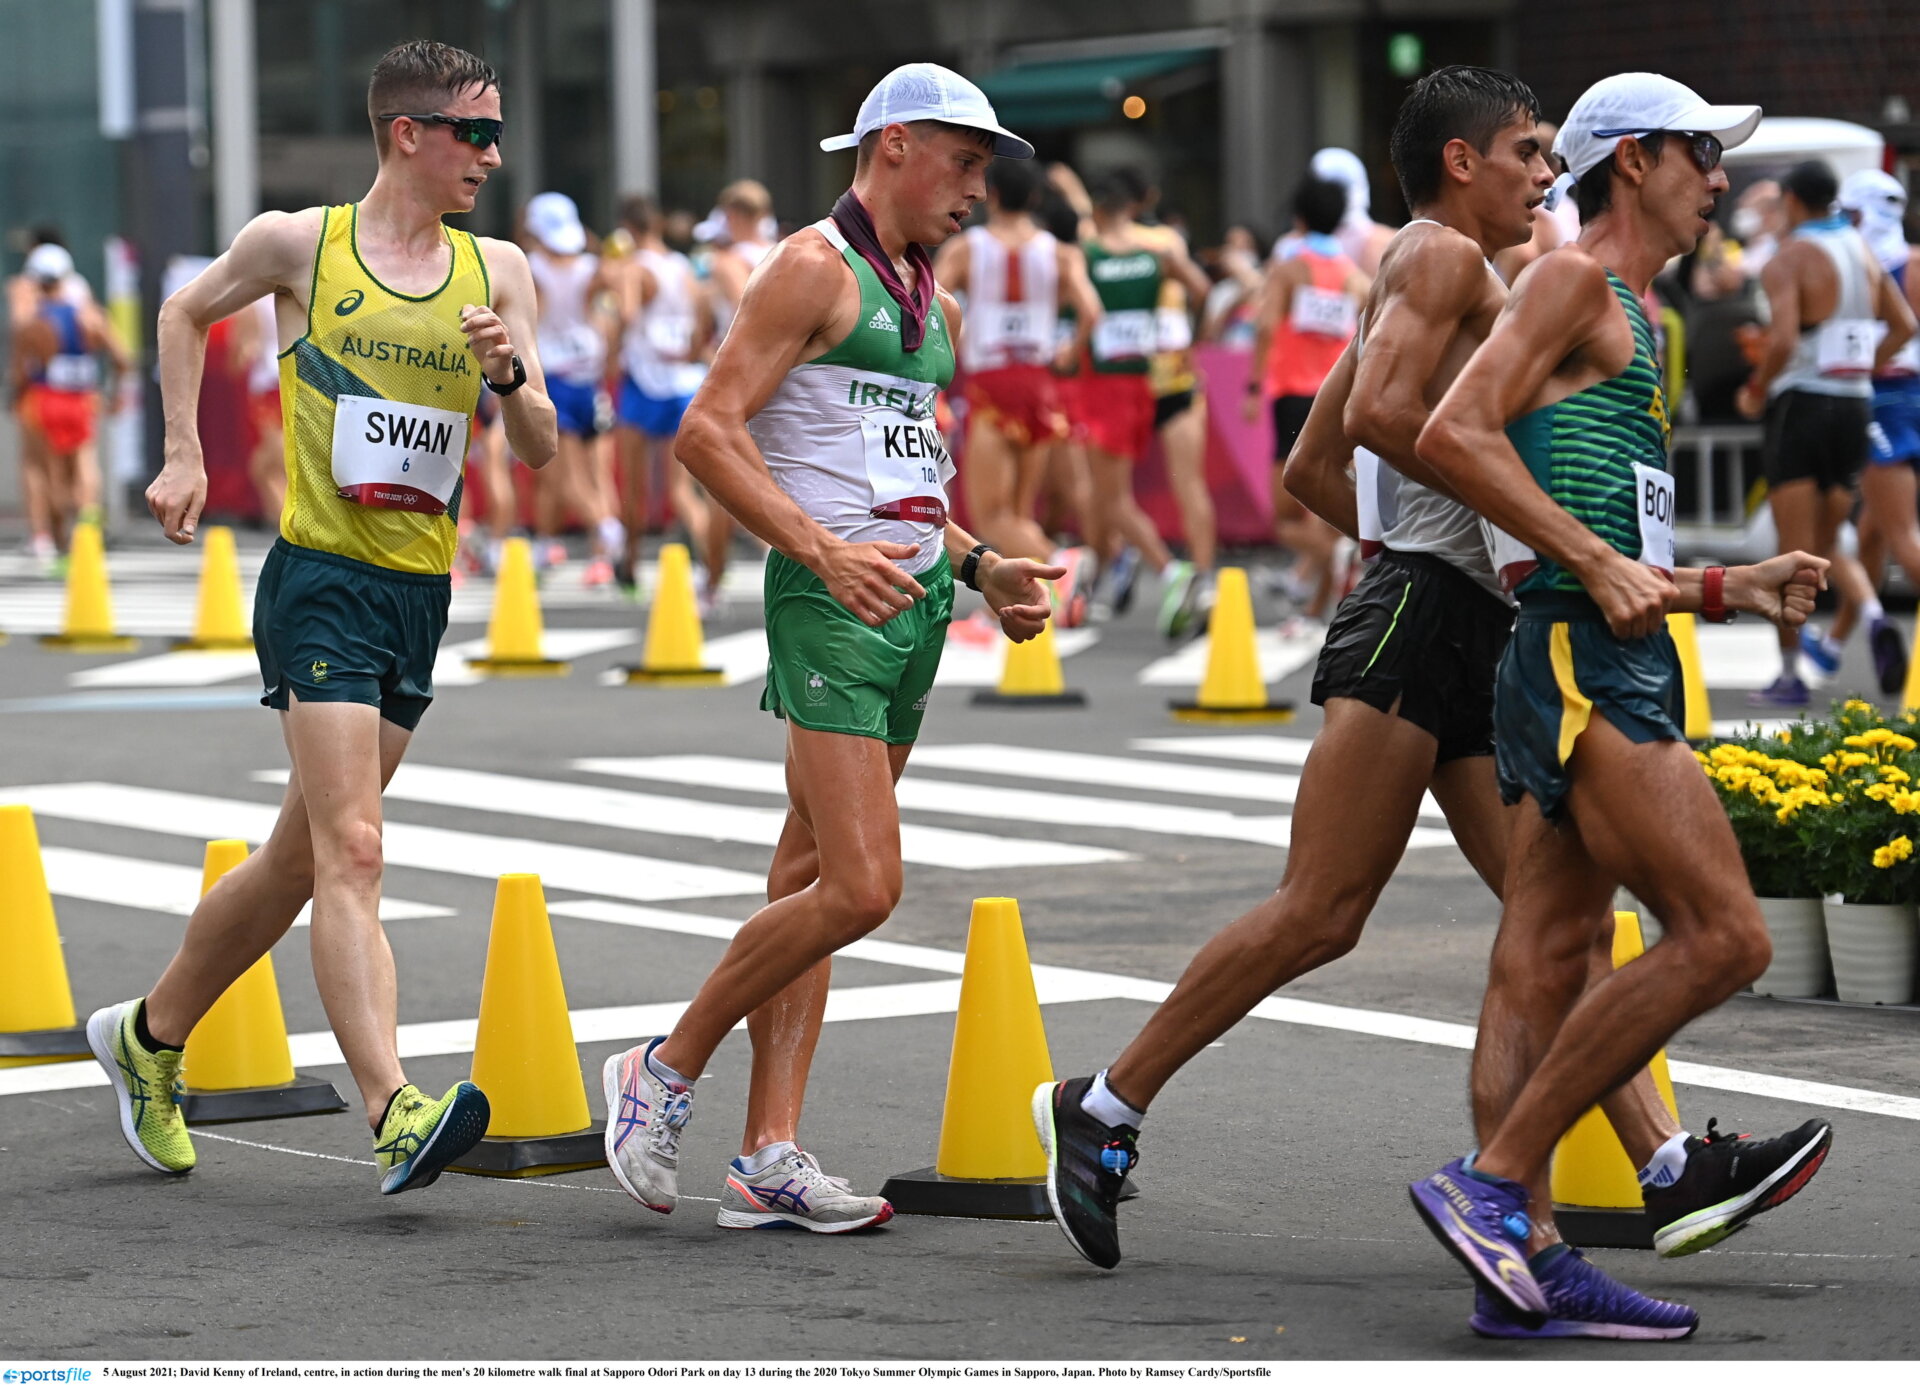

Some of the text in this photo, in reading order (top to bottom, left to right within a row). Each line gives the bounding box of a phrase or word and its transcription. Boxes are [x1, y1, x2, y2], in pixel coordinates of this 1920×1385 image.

[868, 320, 899, 333] adidas
[341, 335, 467, 378] AUSTRALIA
[364, 411, 453, 456] SWAN
[401, 457, 411, 473] 6
[374, 490, 390, 500] TOKYO
[911, 505, 926, 514] TOKYO
